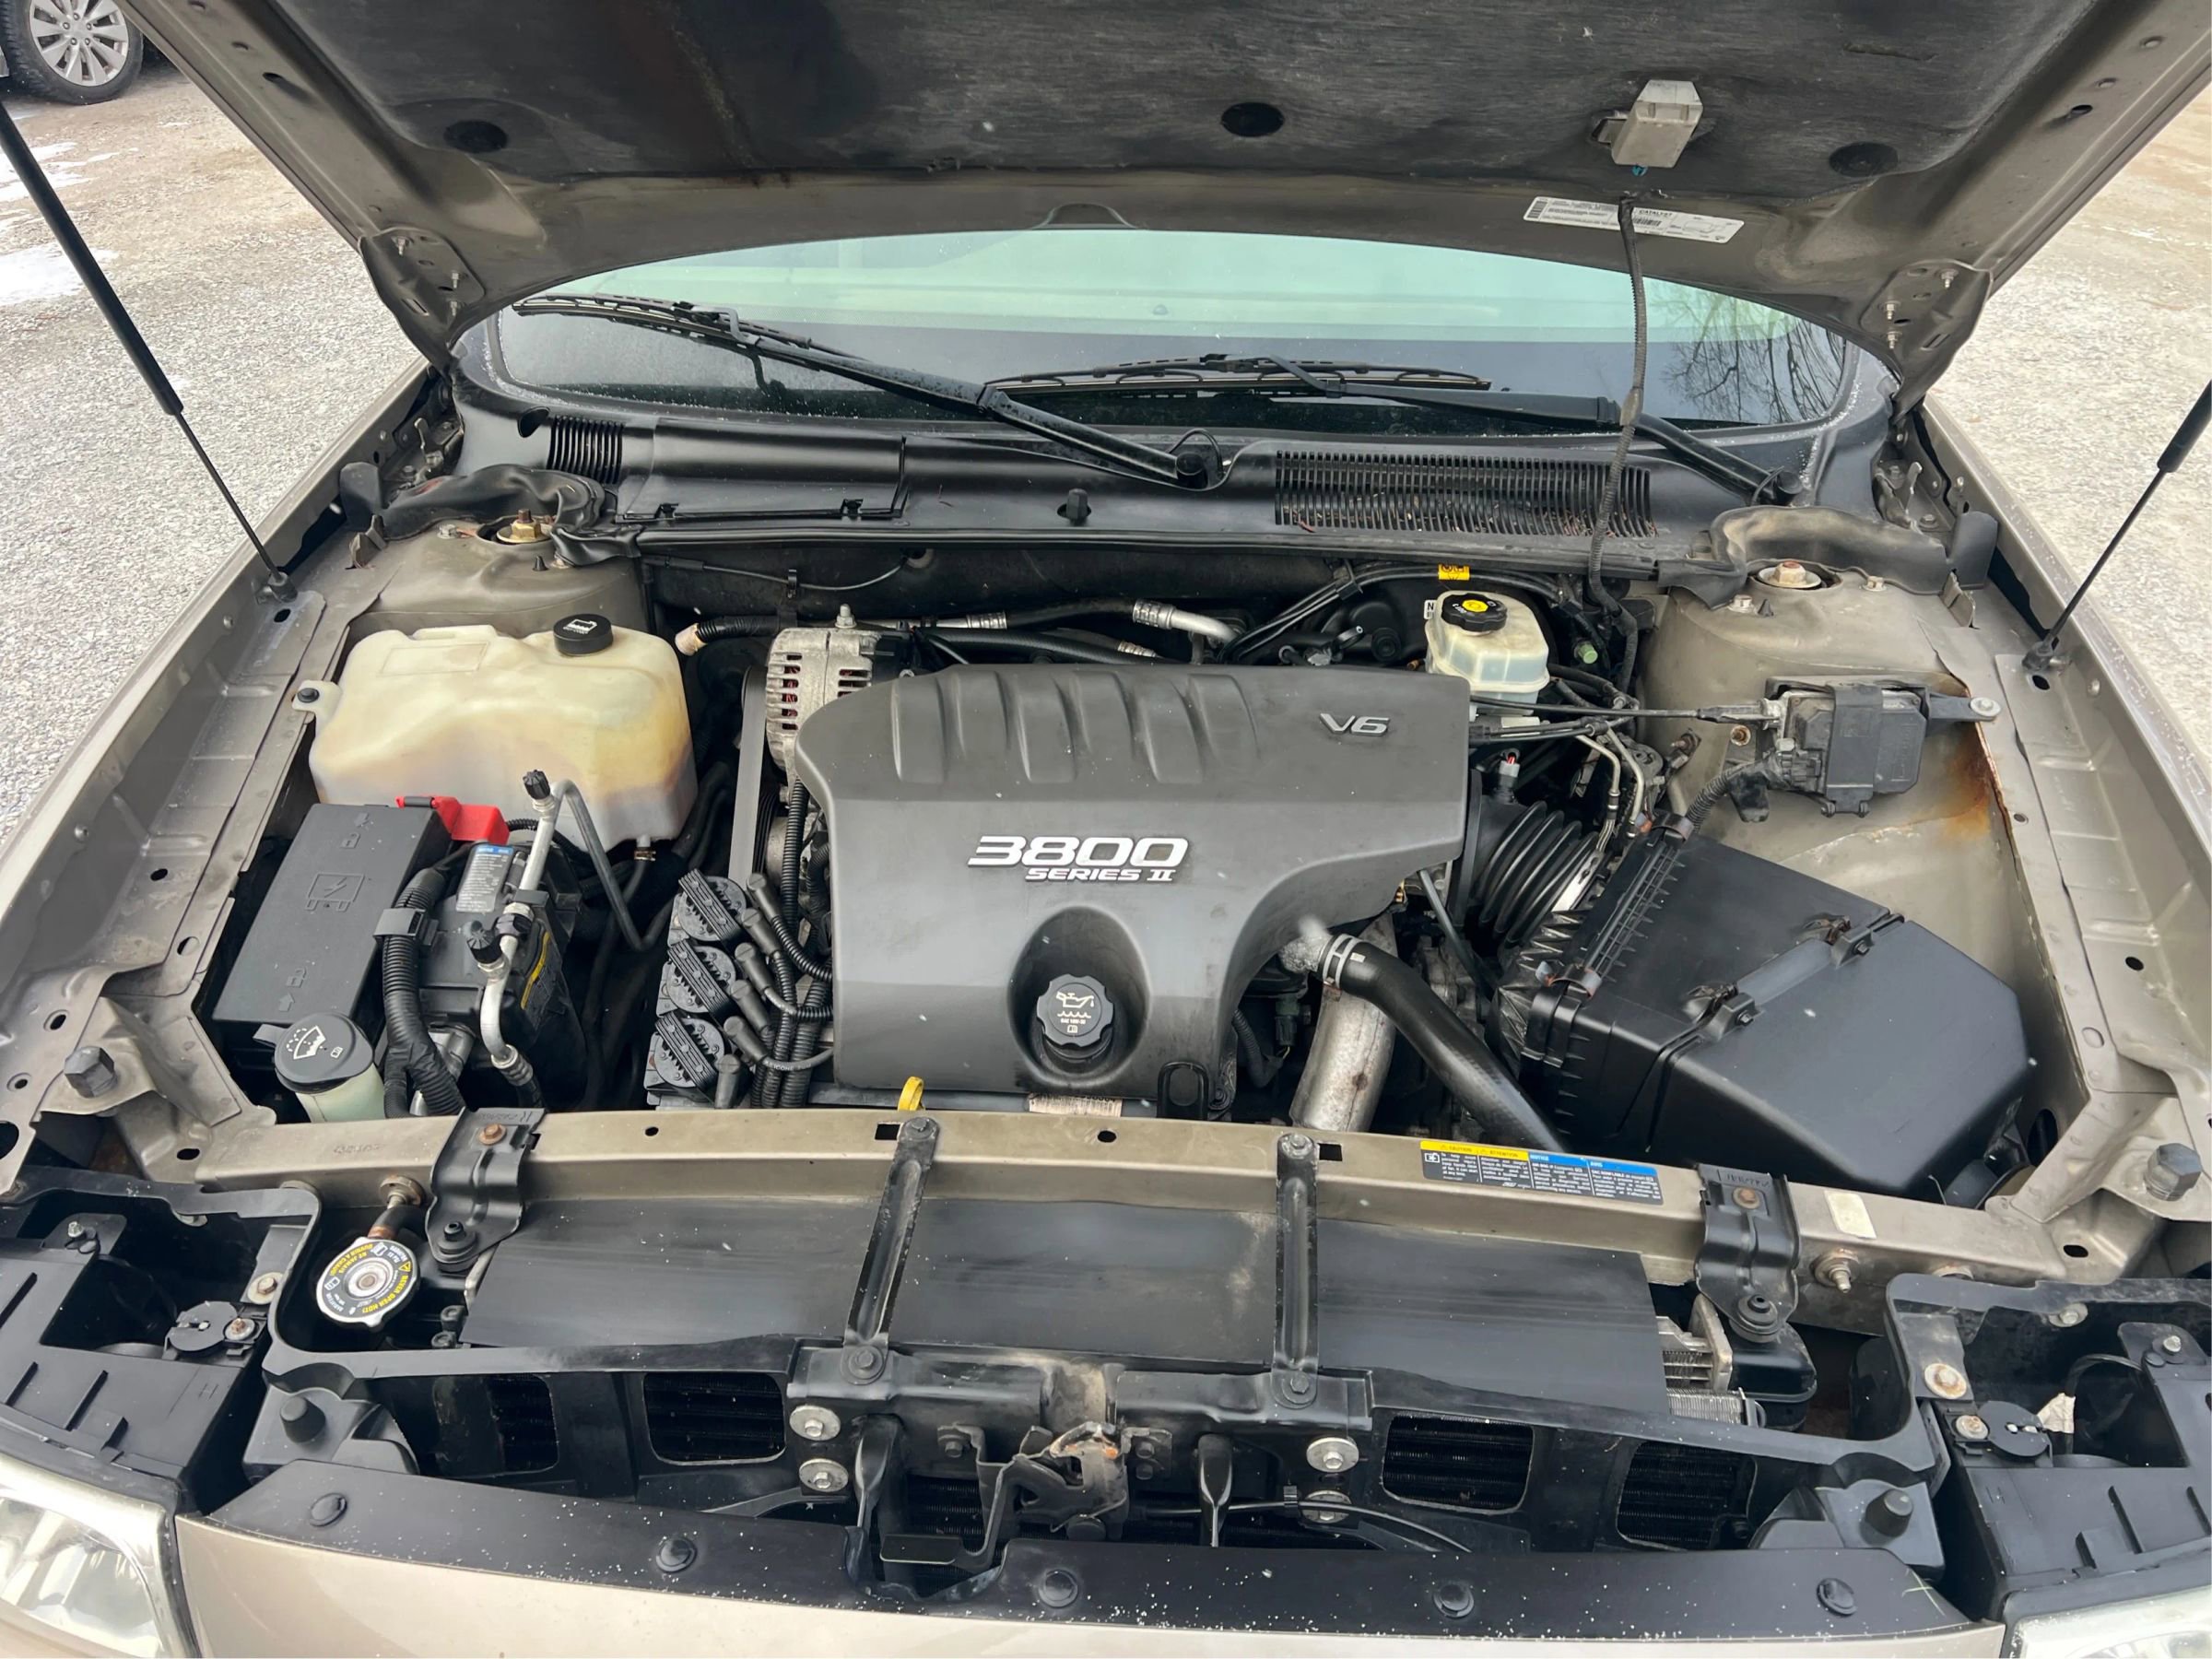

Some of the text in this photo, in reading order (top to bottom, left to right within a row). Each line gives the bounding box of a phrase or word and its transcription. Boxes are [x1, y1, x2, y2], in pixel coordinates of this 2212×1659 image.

[1319, 713, 1390, 736] V6
[968, 836, 1188, 867] 3800
[1025, 868, 1142, 881] SERIES
